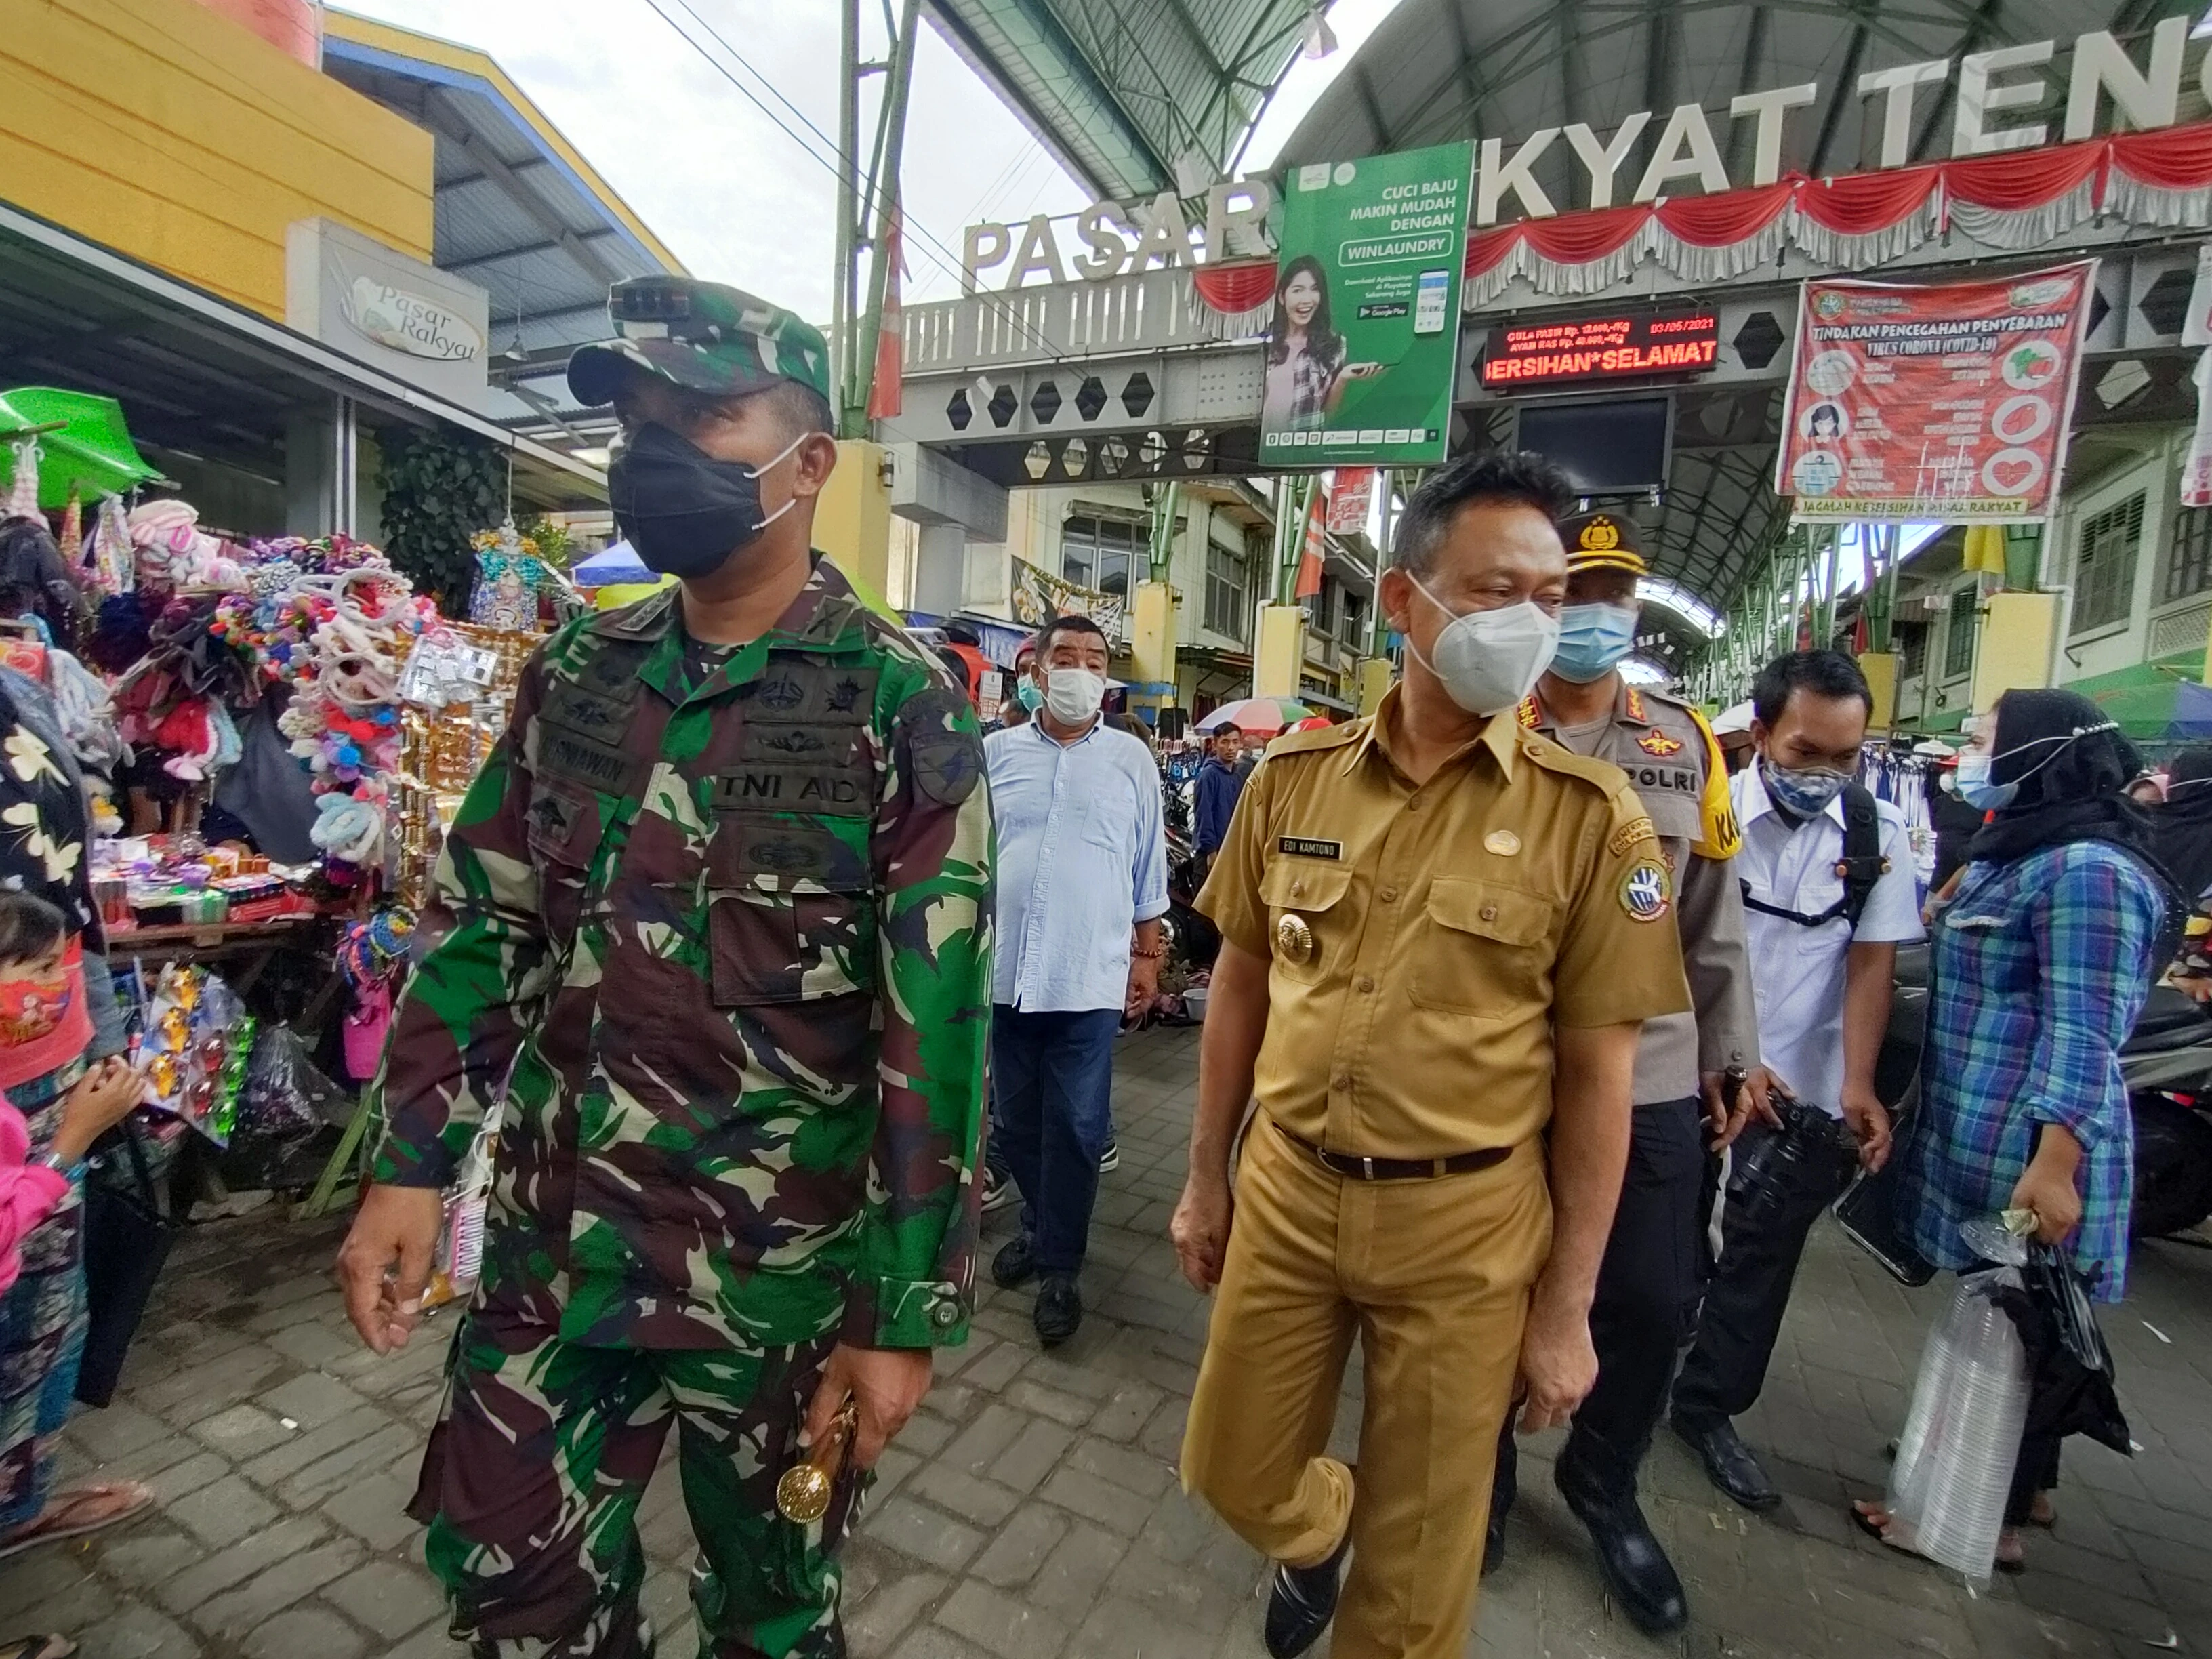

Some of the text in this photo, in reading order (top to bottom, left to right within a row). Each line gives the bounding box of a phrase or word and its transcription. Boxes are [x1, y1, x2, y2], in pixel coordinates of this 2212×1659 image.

[961, 180, 1272, 297] PASAR
[1856, 14, 2212, 169] TEN
[1382, 178, 1458, 201] CUCI BAJU
[1349, 196, 1456, 221] MAKIN MUDAH
[1391, 213, 1455, 232] DENGAN
[1347, 237, 1446, 260] WINLAUNDRY
[377, 284, 451, 329] Pasar
[1371, 308, 1393, 317] Google
[1393, 307, 1407, 315] Play
[399, 314, 475, 363] Rakyat
[1507, 330, 1535, 342] GULA
[1812, 313, 2068, 341] TINDAKAN PENCEGAHAN PENYEBARAN
[1867, 340, 1897, 356] VIRUS
[1898, 338, 1940, 356] CORONA
[1803, 501, 1851, 512] JAGALAH
[1969, 501, 2022, 512] RAKYAT
[720, 773, 859, 803] TNI AD
[1623, 767, 1696, 792] POLRI
[1284, 840, 1334, 855] EDI KAMTONO
